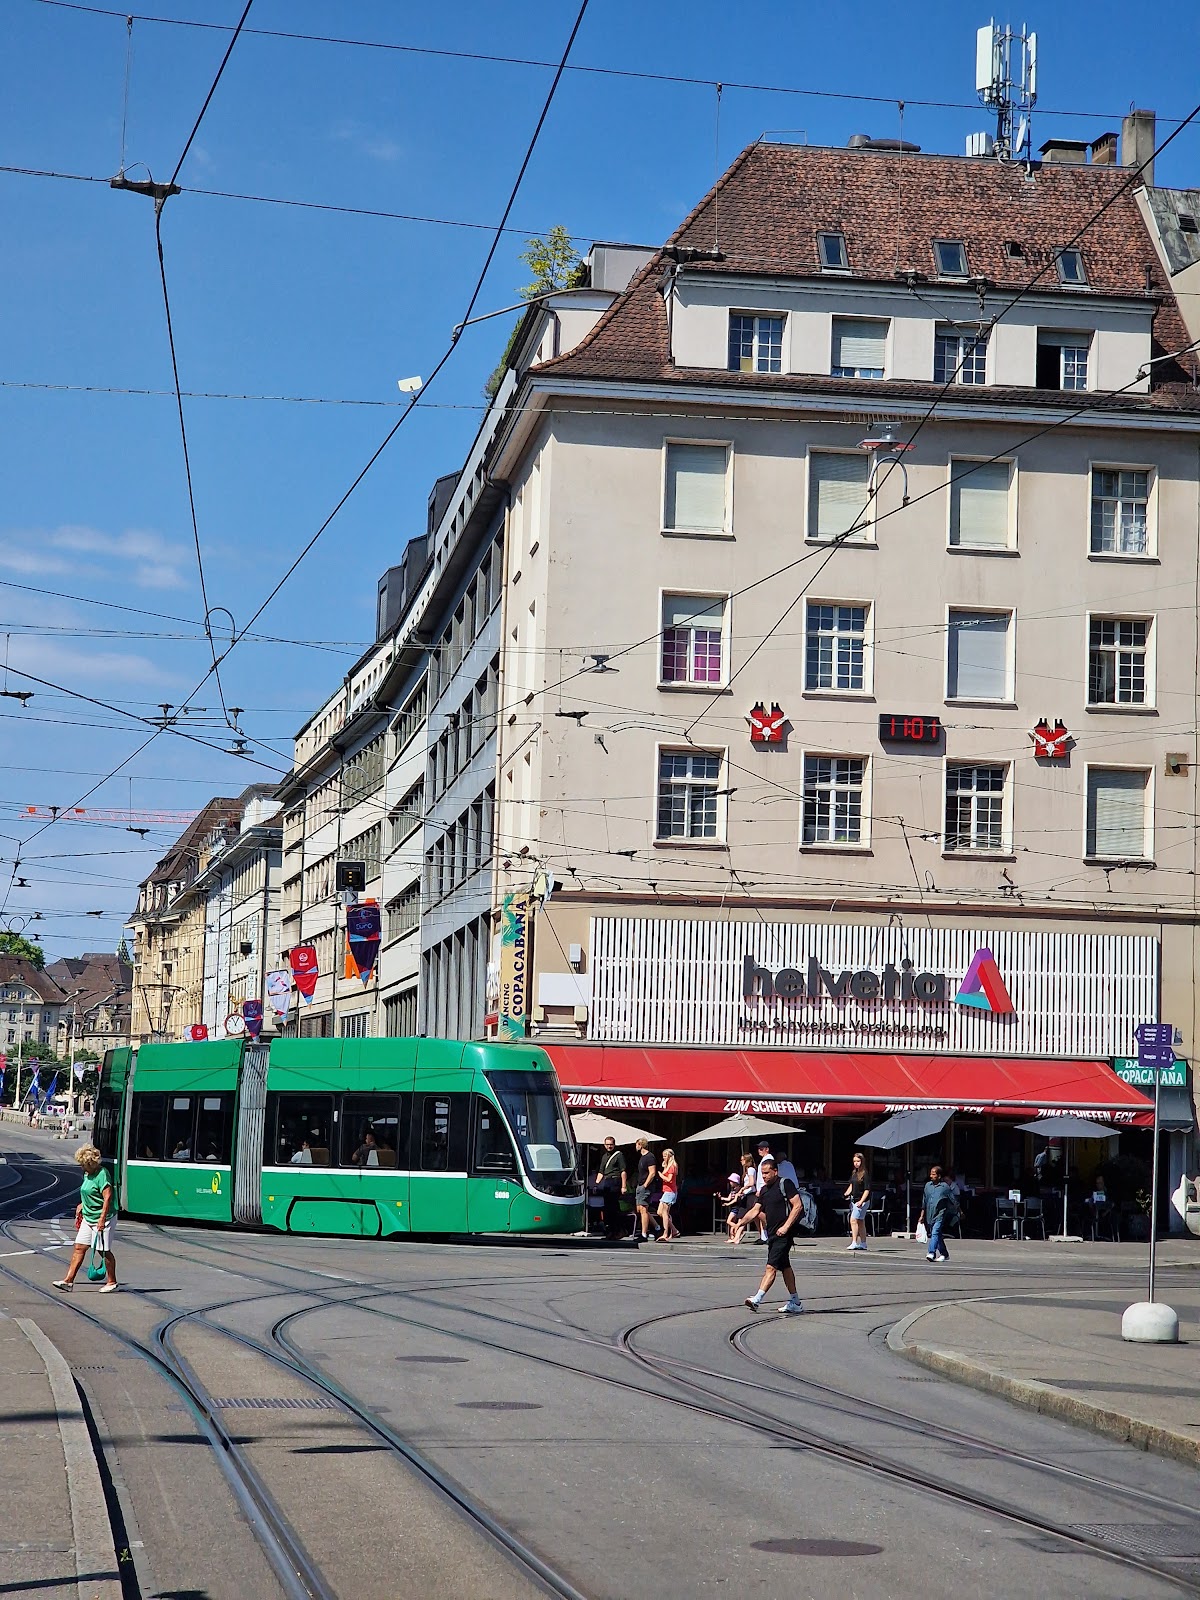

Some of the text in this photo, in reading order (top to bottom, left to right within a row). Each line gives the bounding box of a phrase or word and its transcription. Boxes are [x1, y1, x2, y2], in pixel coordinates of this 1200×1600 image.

[891, 717, 937, 739] 11:01
[512, 900, 527, 1016] COPACABANA
[742, 955, 946, 1001] helvetia
[502, 983, 510, 1027] DANCING
[739, 1017, 767, 1028] Ihre
[773, 1017, 845, 1031] Schweizer
[1116, 1069, 1184, 1085] COPACAANA
[565, 1093, 670, 1109] ZUM SCHIEFEN ECK
[723, 1099, 827, 1114] ZUM SCHIEFEN ECK
[1112, 1111, 1137, 1123] ECK
